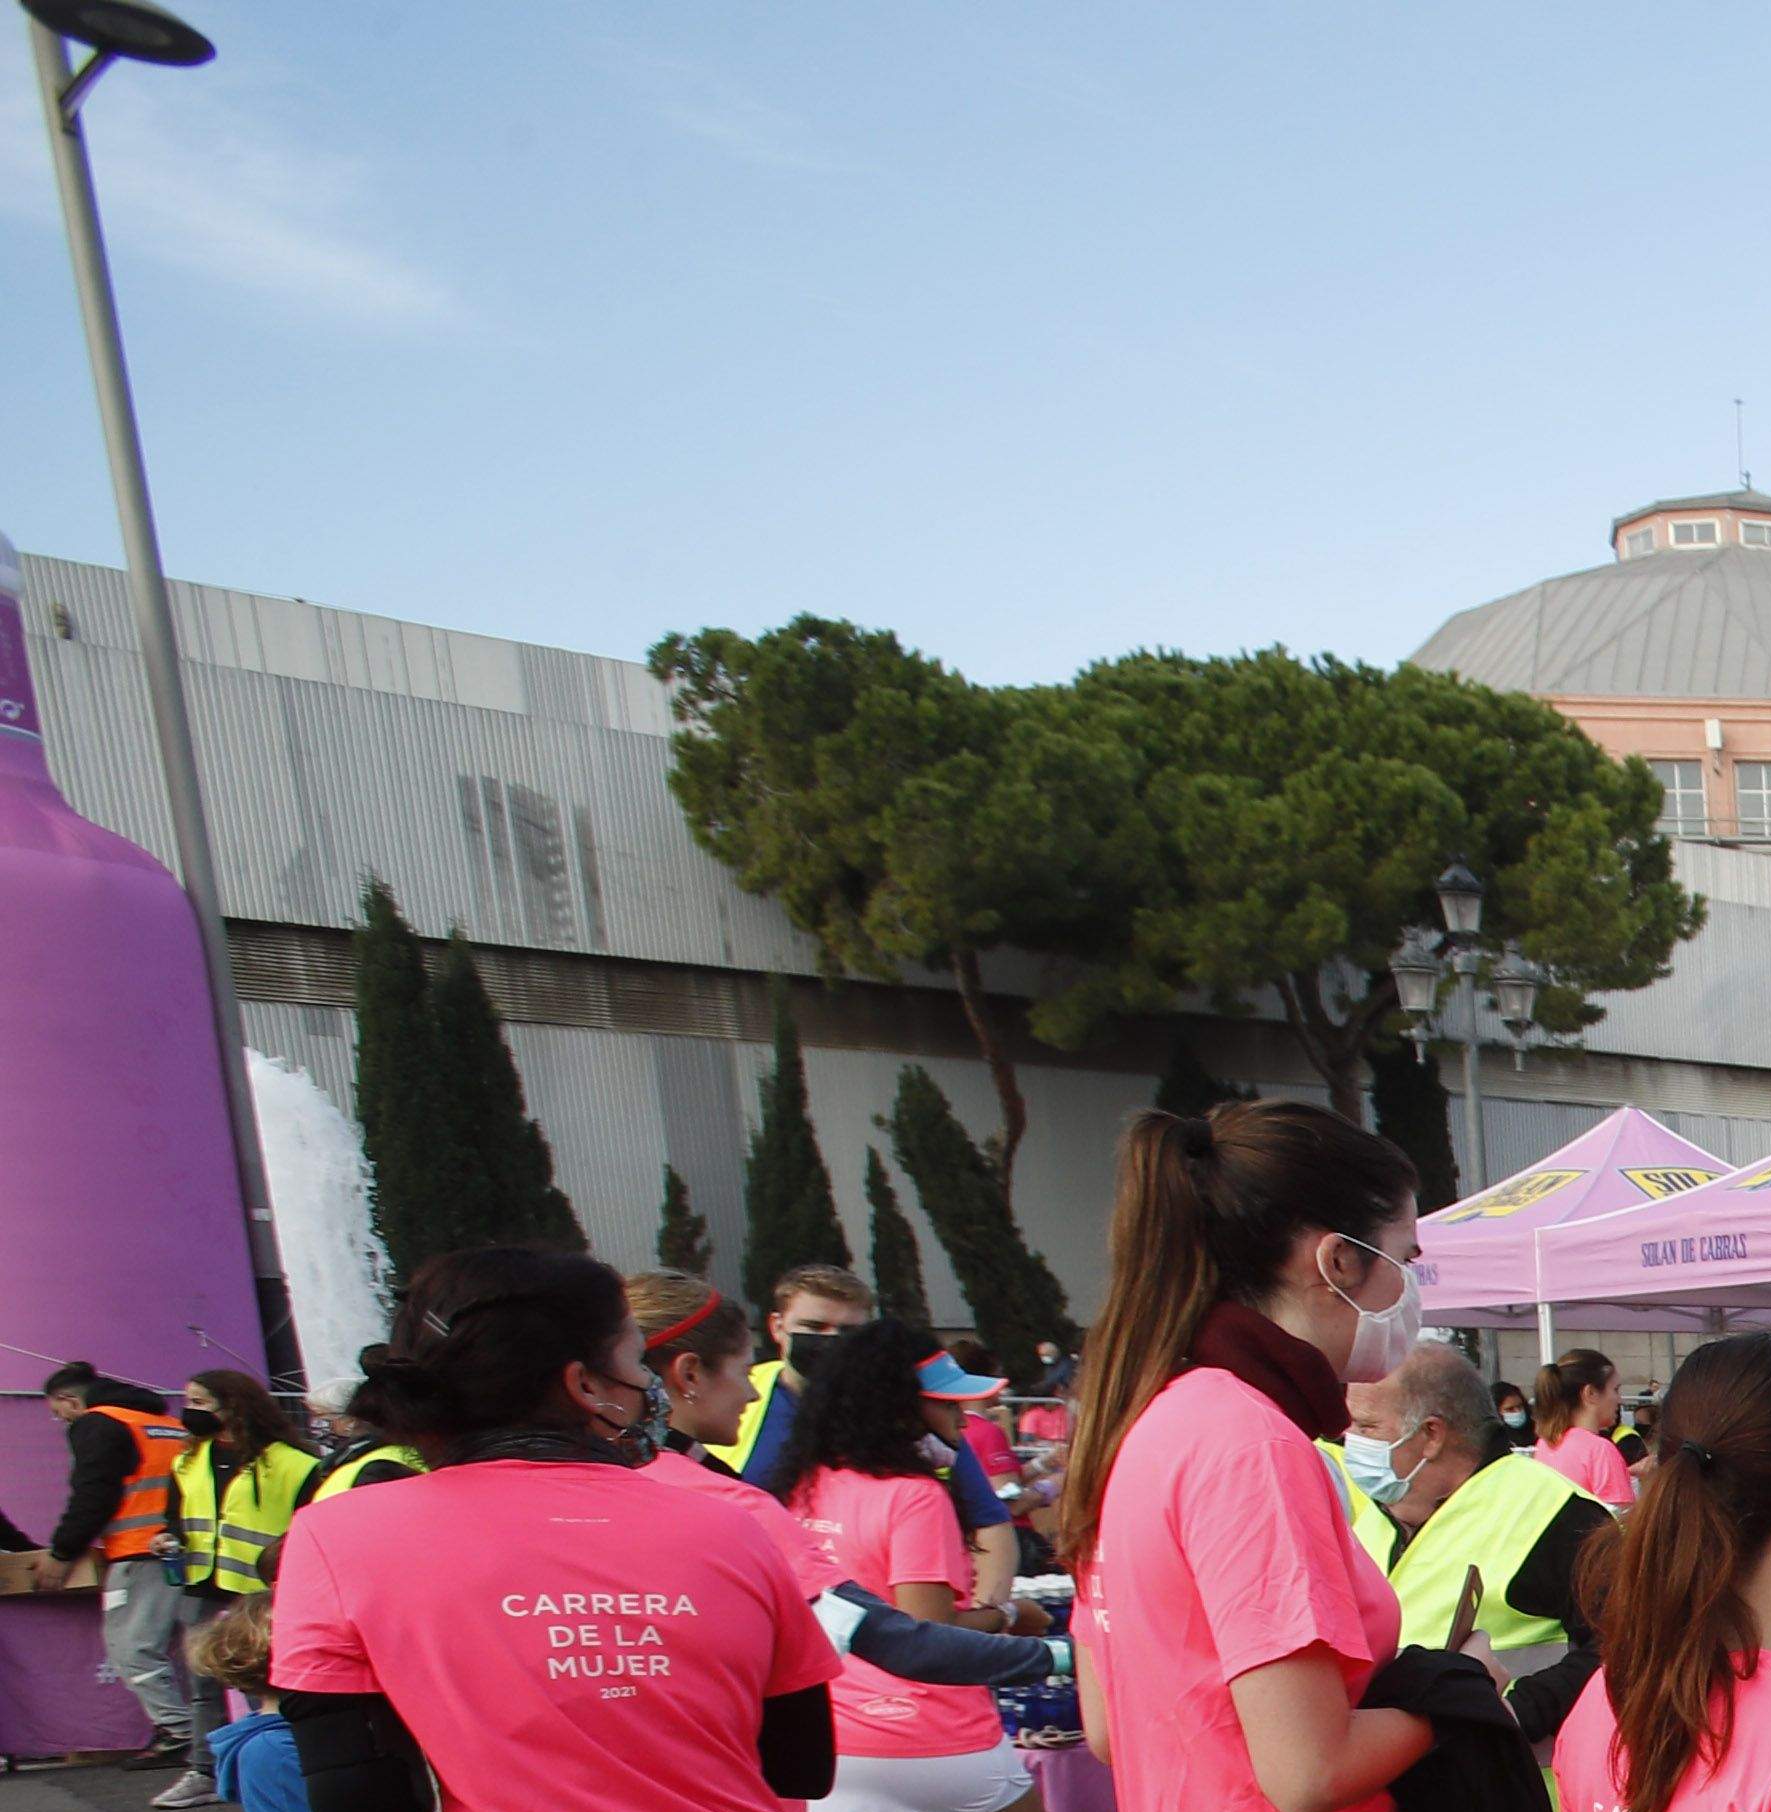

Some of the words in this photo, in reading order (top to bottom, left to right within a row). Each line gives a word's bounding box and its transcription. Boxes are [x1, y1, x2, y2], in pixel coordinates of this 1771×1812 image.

[1641, 1239, 1677, 1268] SOLAN
[1681, 1237, 1697, 1264] DE
[1700, 1233, 1748, 1262] CABRAS
[501, 1593, 699, 1617] CARRERA
[548, 1625, 602, 1648] DE
[614, 1625, 663, 1647] LA
[547, 1654, 671, 1680] MUJER
[600, 1685, 637, 1700] 2021
